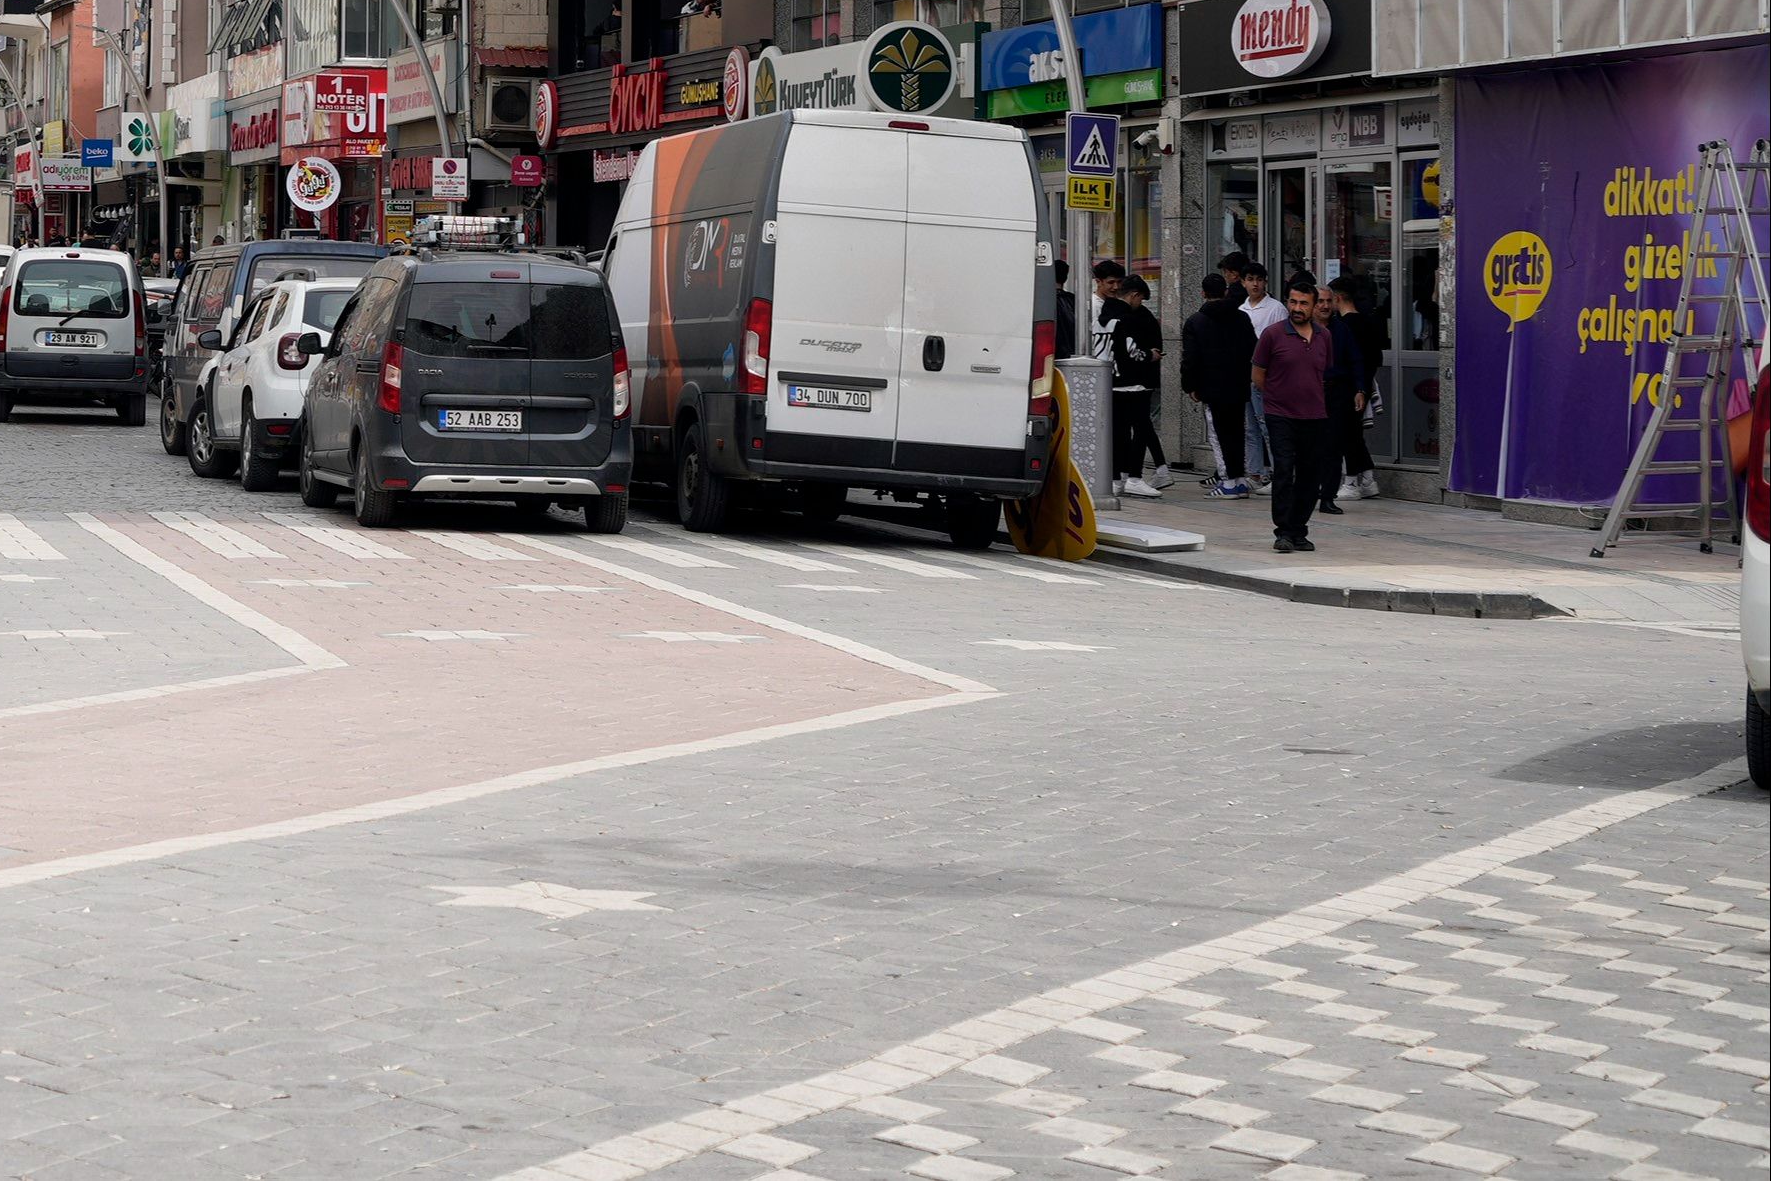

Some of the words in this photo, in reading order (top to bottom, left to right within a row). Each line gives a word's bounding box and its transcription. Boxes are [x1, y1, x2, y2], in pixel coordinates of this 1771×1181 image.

[317, 94, 365, 105] NOTER
[610, 58, 668, 135] ÖNCÜ
[1353, 114, 1378, 137] NBB
[86, 147, 109, 155] beko
[1073, 181, 1099, 195] İLK
[1604, 163, 1695, 217] dikkat!
[1492, 241, 1545, 297] gratis
[52, 333, 62, 343] 29
[80, 333, 96, 344] 921
[796, 388, 811, 402] 34
[817, 391, 840, 405] DUN
[845, 393, 867, 407] 700
[446, 412, 461, 426] 52
[469, 413, 492, 426] AAB
[497, 413, 519, 427] 253
